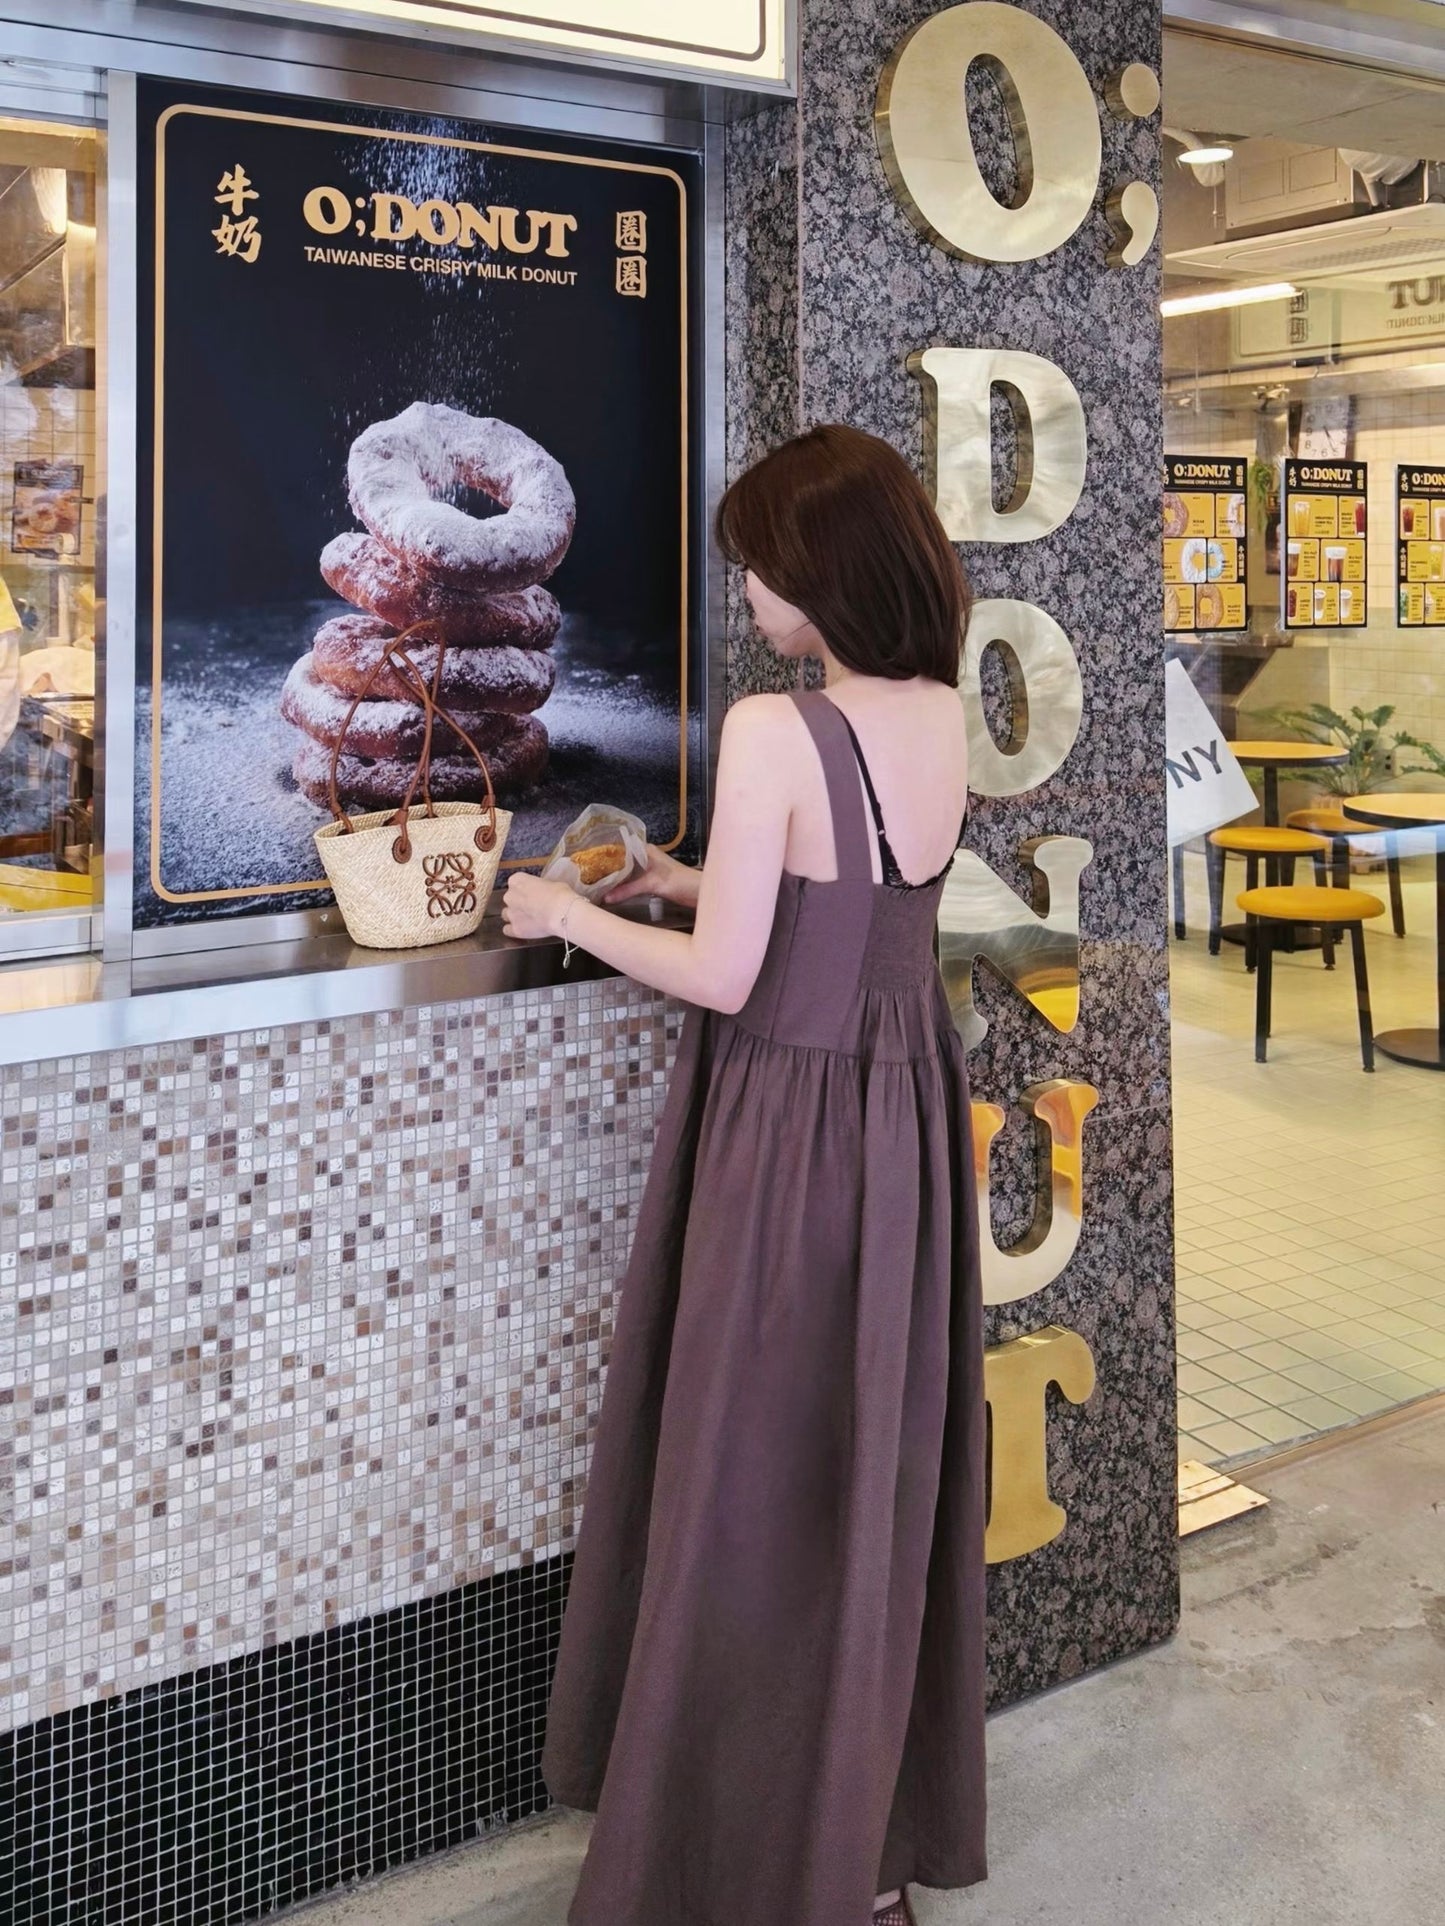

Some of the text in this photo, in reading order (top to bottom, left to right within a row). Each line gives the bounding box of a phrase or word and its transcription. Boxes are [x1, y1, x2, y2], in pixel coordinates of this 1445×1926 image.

[211, 163, 262, 264] 牛奶
[303, 185, 578, 258] O;DONUT
[303, 246, 578, 286] TAIWANESE CRISPY MILK DONUT
[615, 210, 647, 299] 圈圈
[1174, 463, 1231, 478] O;DONUT
[1300, 467, 1353, 482] O;DONUT
